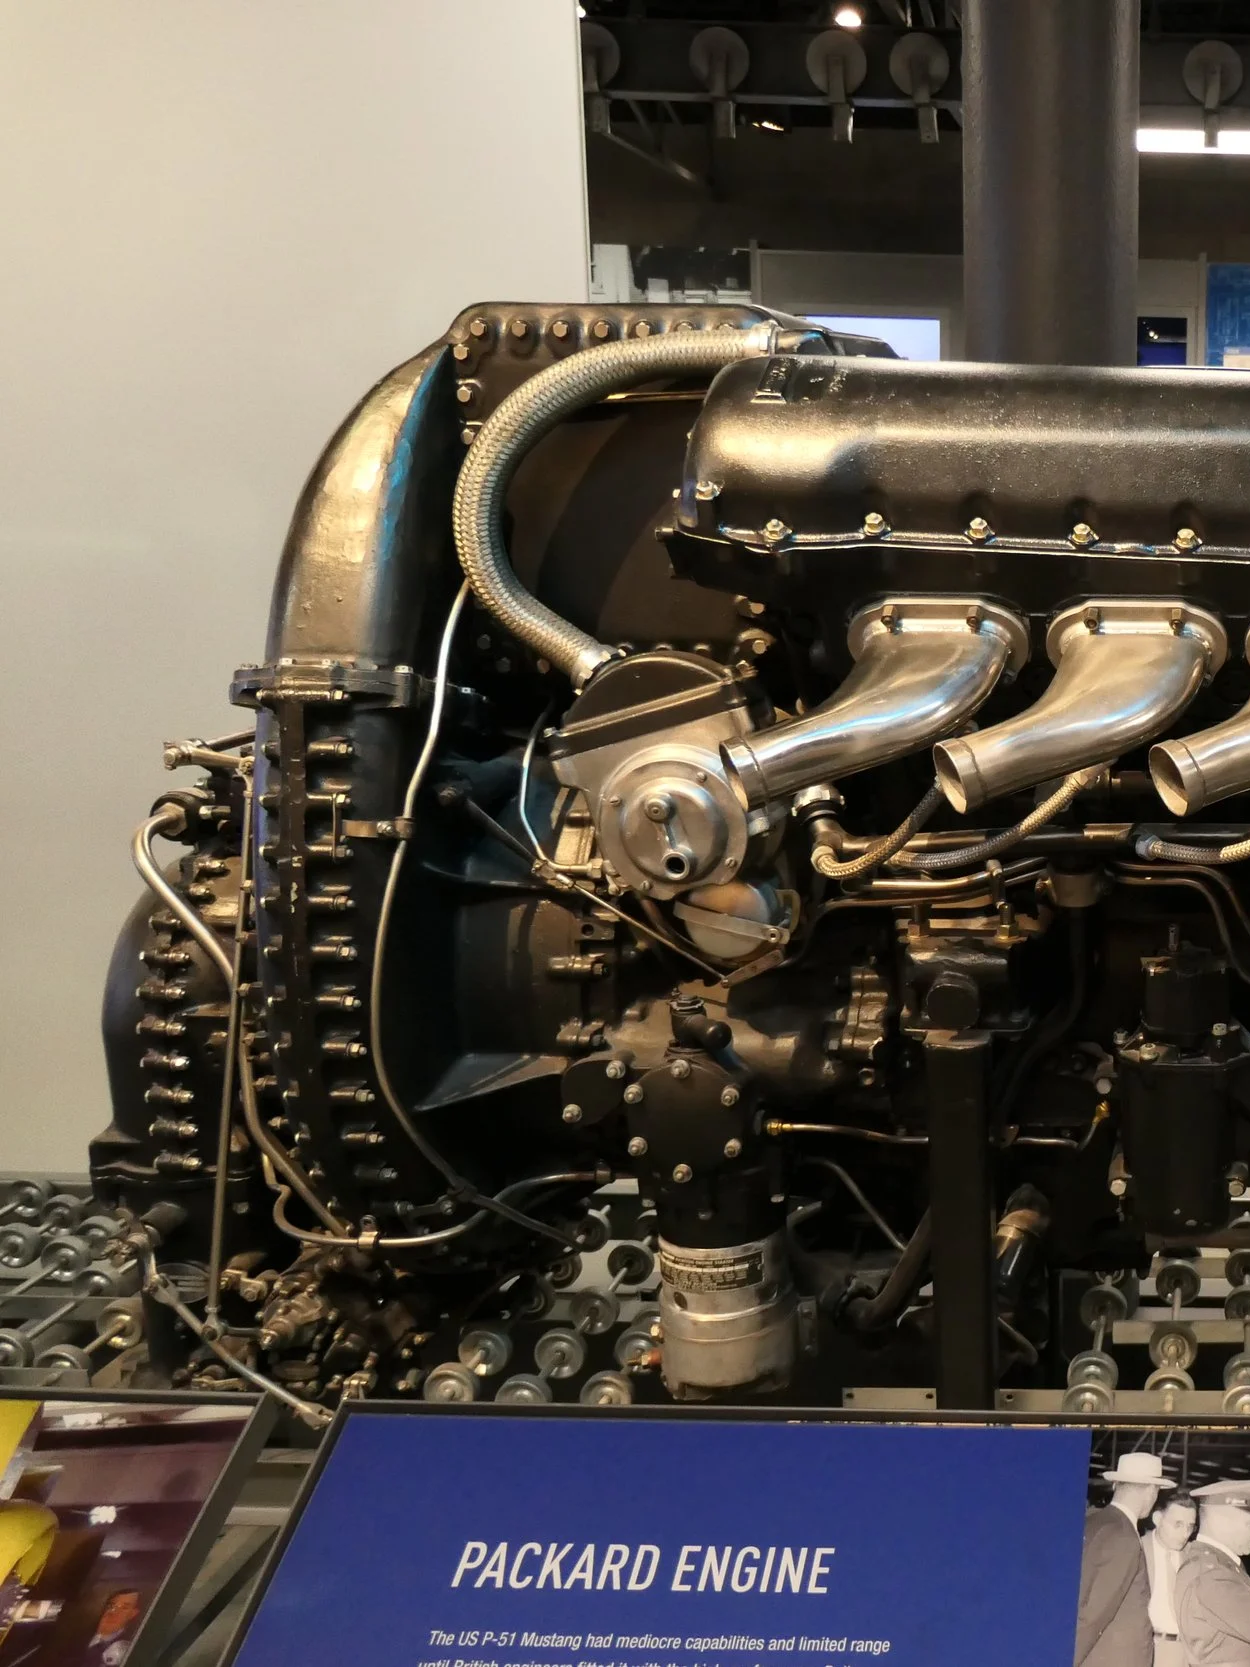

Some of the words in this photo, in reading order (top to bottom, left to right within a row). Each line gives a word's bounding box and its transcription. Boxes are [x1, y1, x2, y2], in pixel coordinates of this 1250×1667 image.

[450, 1541, 661, 1591] PACKARD
[670, 1545, 836, 1594] ENGINE
[429, 1630, 455, 1646] The
[457, 1631, 480, 1646] US
[481, 1632, 517, 1647] P-51
[519, 1632, 583, 1651] Mustang
[584, 1633, 614, 1649] had
[615, 1633, 682, 1650] mediocre
[684, 1635, 765, 1652] capabilities
[767, 1636, 796, 1652] and
[798, 1636, 848, 1652] limited
[849, 1639, 891, 1656] range
